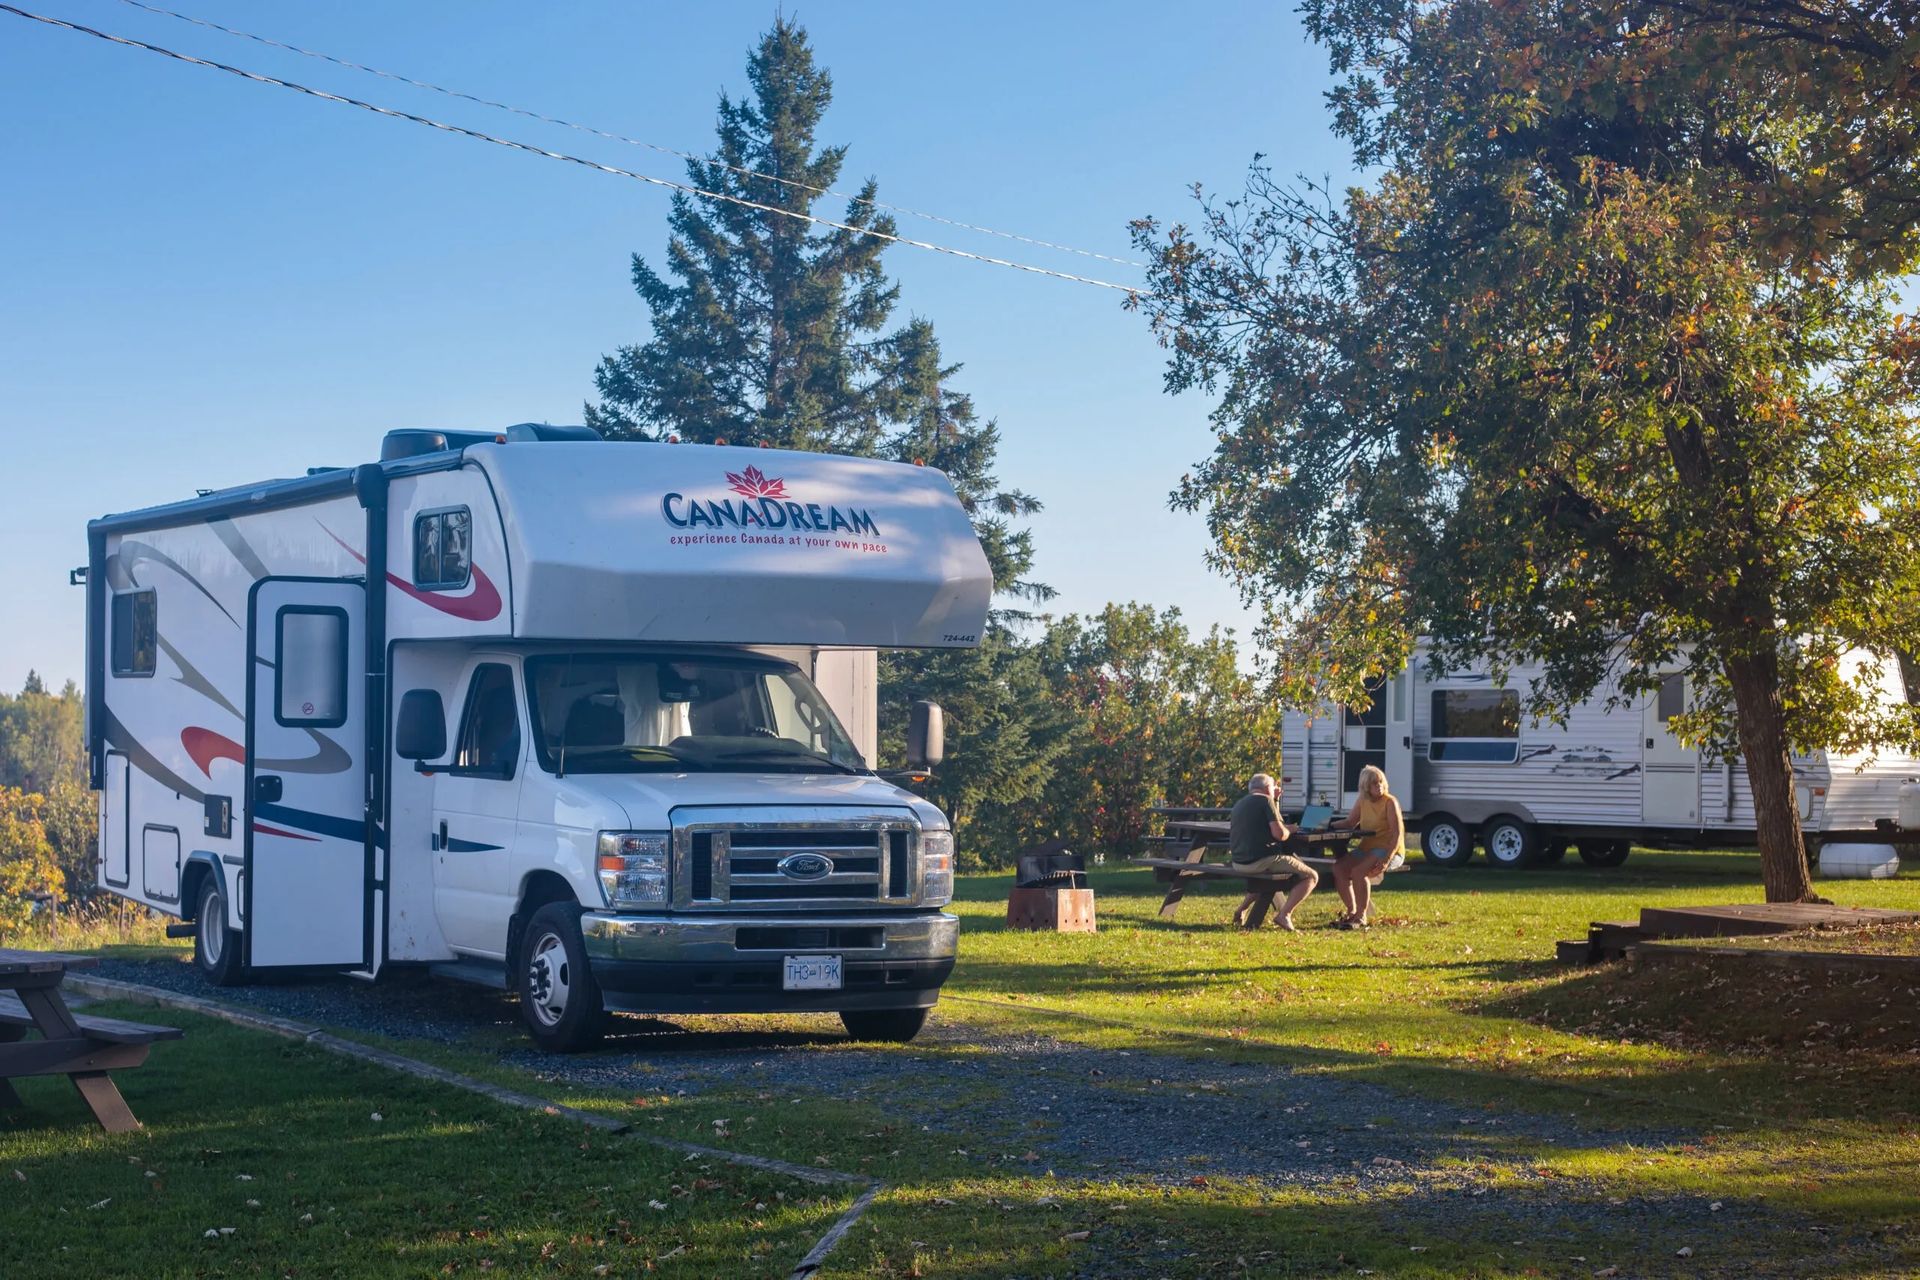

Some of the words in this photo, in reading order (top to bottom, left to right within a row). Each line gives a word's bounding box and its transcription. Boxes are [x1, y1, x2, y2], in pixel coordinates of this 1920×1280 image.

[661, 492, 880, 538] CANADREAM
[670, 533, 737, 546] experience
[741, 532, 785, 545] Canada
[788, 536, 801, 545] at
[805, 537, 831, 548] your
[834, 540, 859, 550] own
[862, 542, 888, 553] pace
[797, 860, 820, 871] Ford
